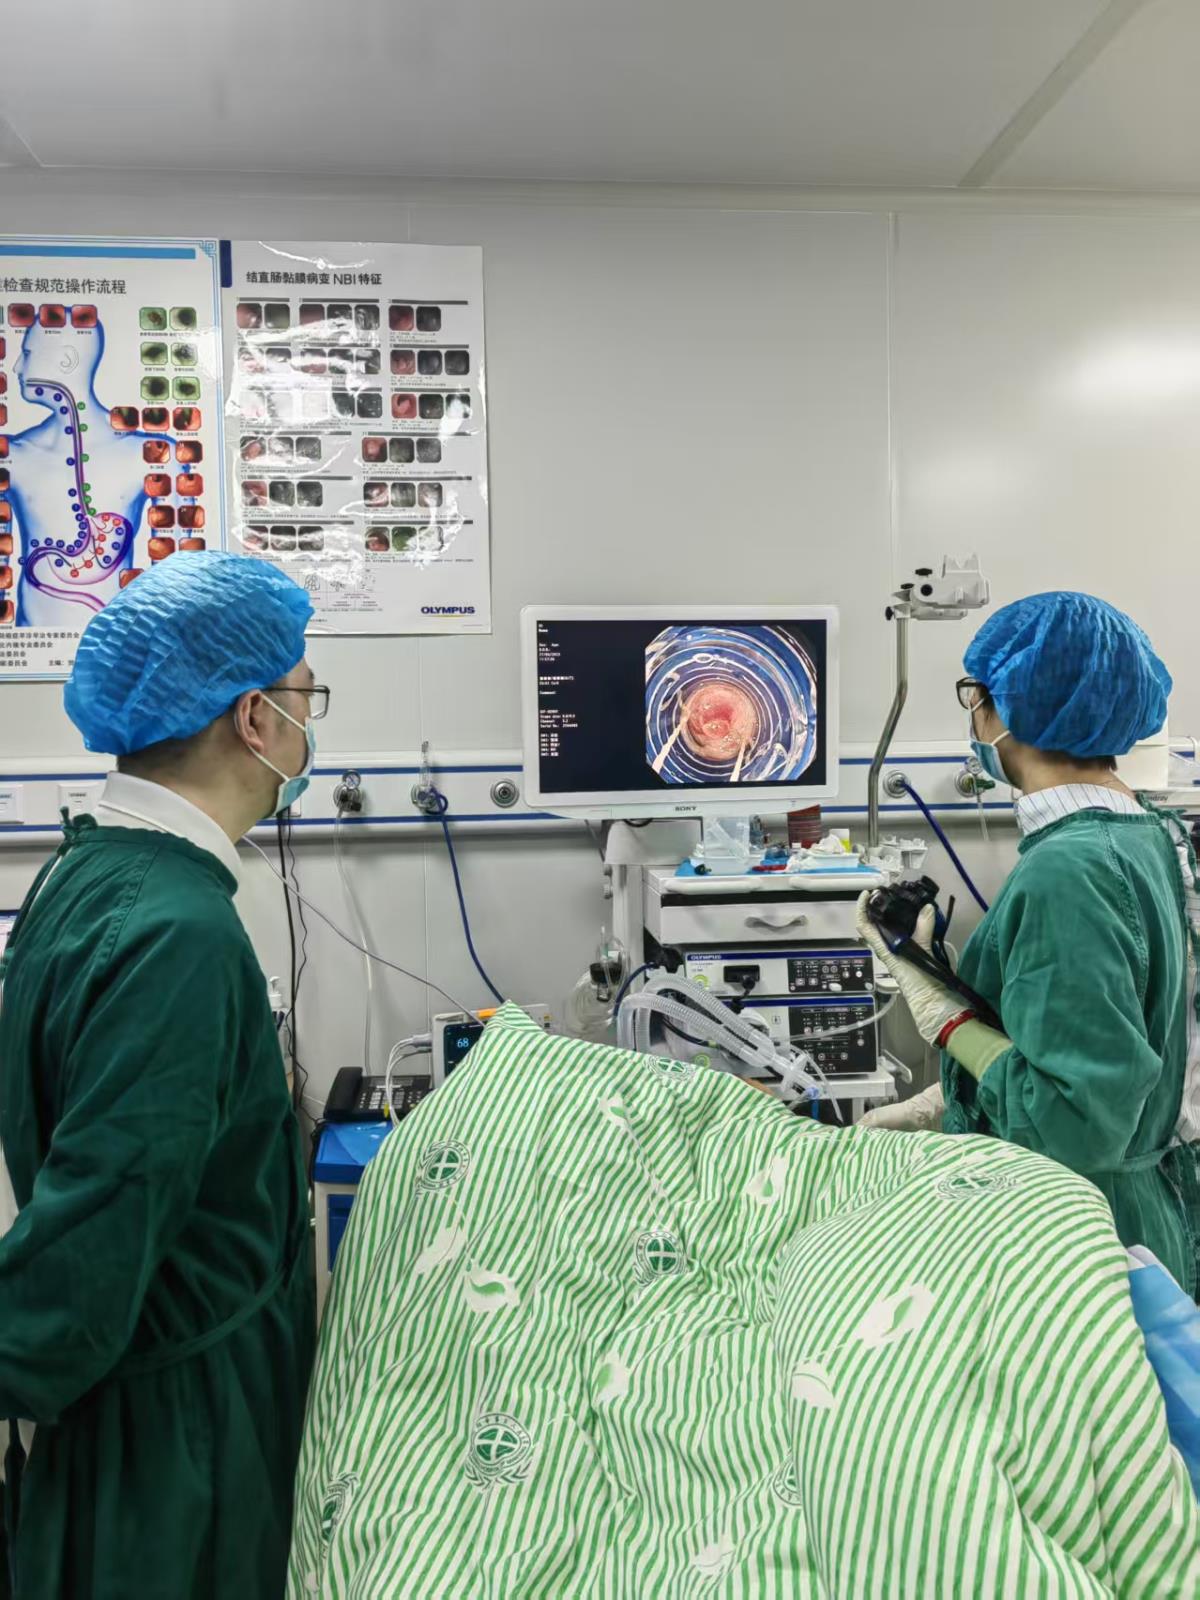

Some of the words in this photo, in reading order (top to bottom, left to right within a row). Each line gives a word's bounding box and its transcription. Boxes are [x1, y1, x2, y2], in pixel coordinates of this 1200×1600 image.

[0, 277, 127, 294] 检查规范操作流程
[421, 606, 475, 614] OLYMPUS
[457, 1037, 469, 1048] 68
